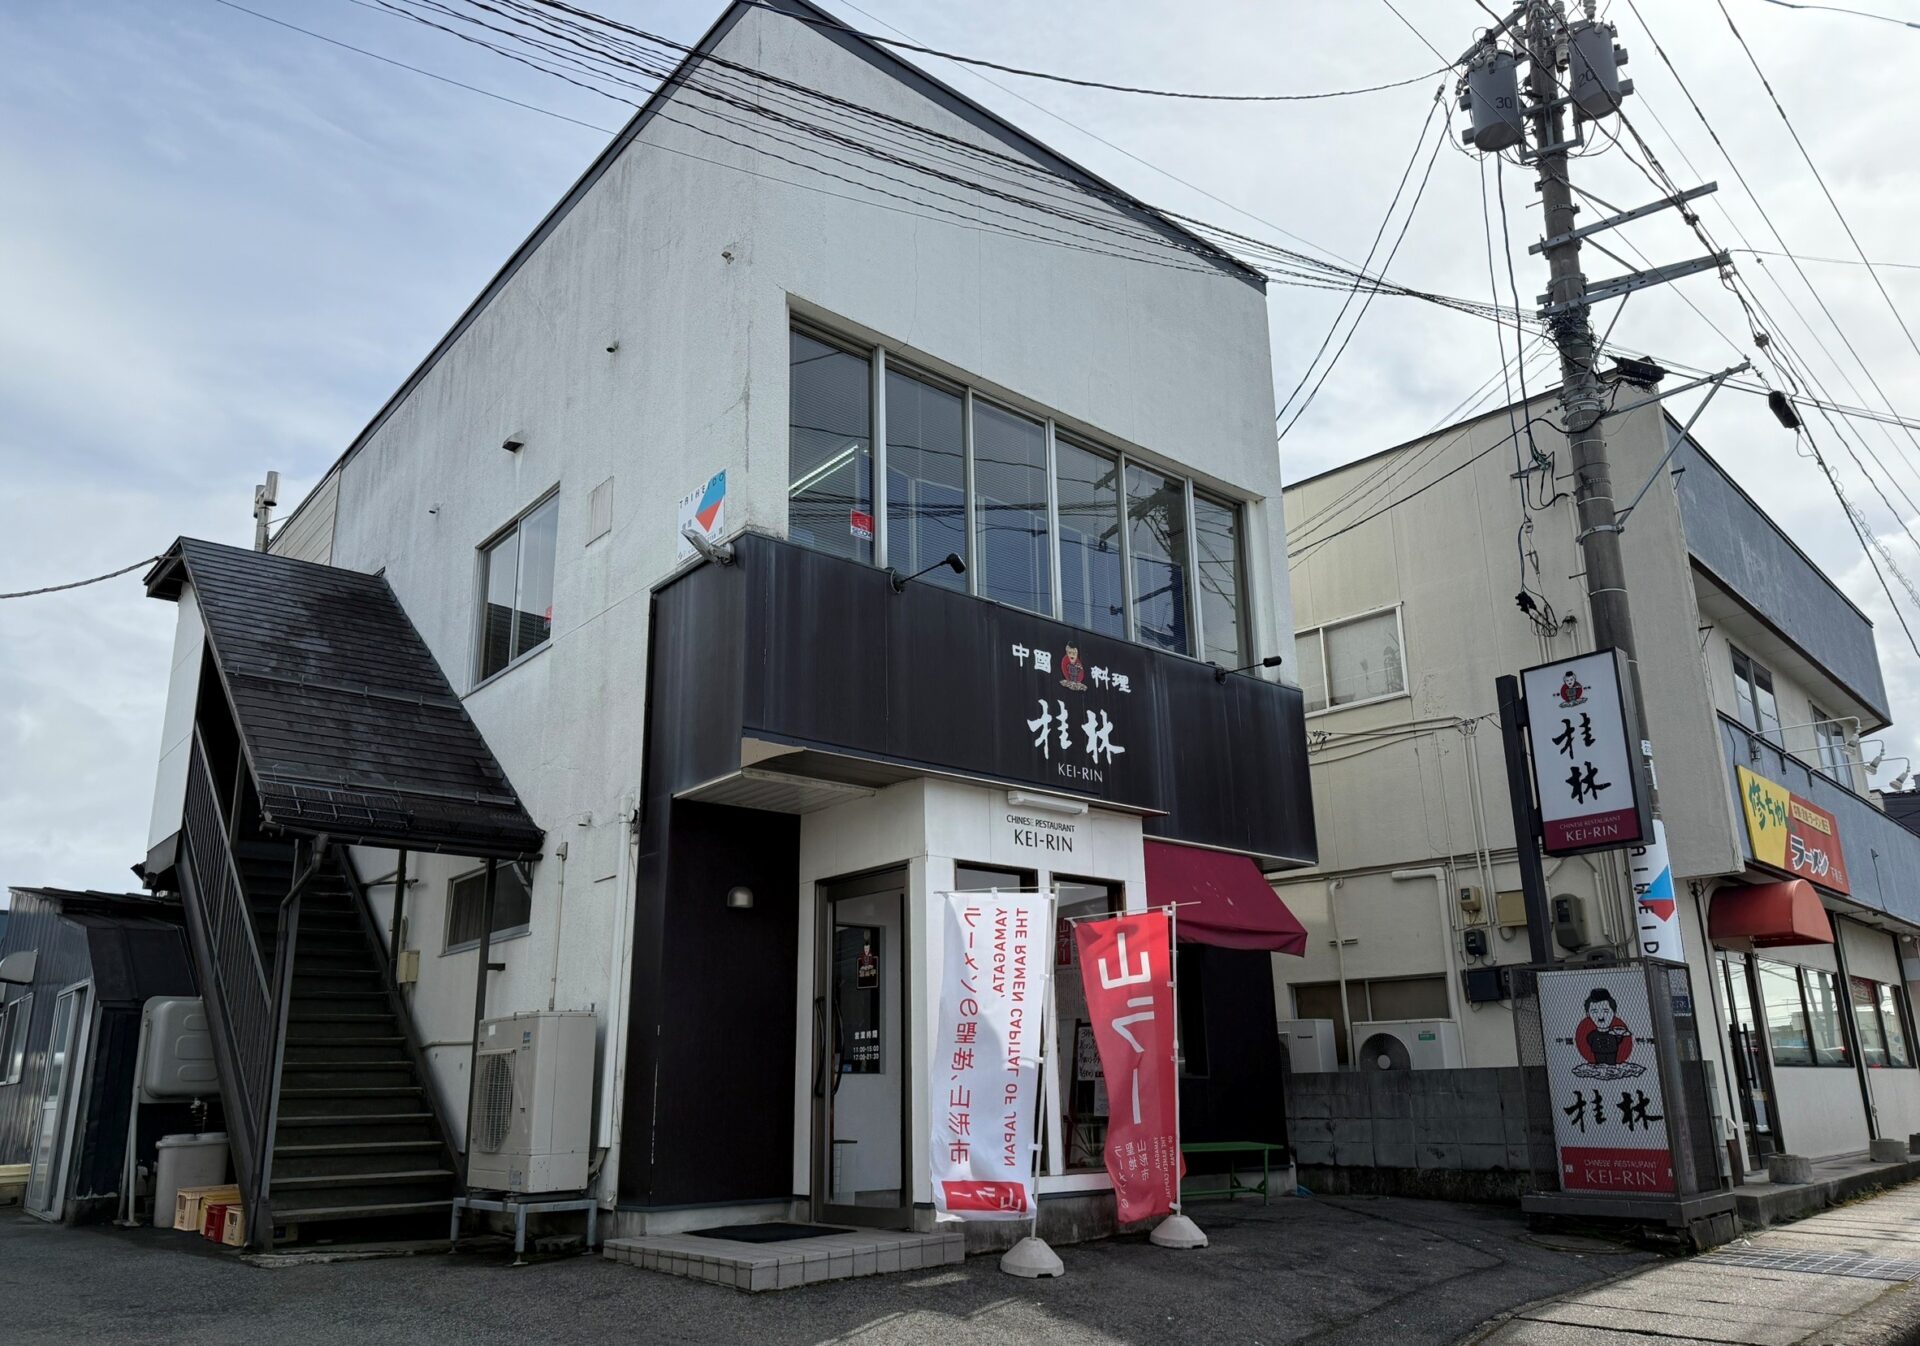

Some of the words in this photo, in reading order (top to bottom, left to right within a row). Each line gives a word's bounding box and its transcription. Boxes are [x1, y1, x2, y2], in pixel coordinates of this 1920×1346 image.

[1578, 70, 1596, 87] 20
[1495, 96, 1512, 109] 30
[1090, 666, 1131, 693] 料理
[1027, 698, 1125, 765] 桂林
[1552, 713, 1612, 804] 桂林
[1058, 763, 1103, 783] KEI-RIN
[1014, 829, 1072, 852] KEI-RIN
[1566, 825, 1618, 842] KEI-RIN
[1790, 834, 1828, 877] ラーメン
[1564, 1089, 1664, 1133] 桂林
[1585, 1169, 1657, 1186] KEI-RIN
